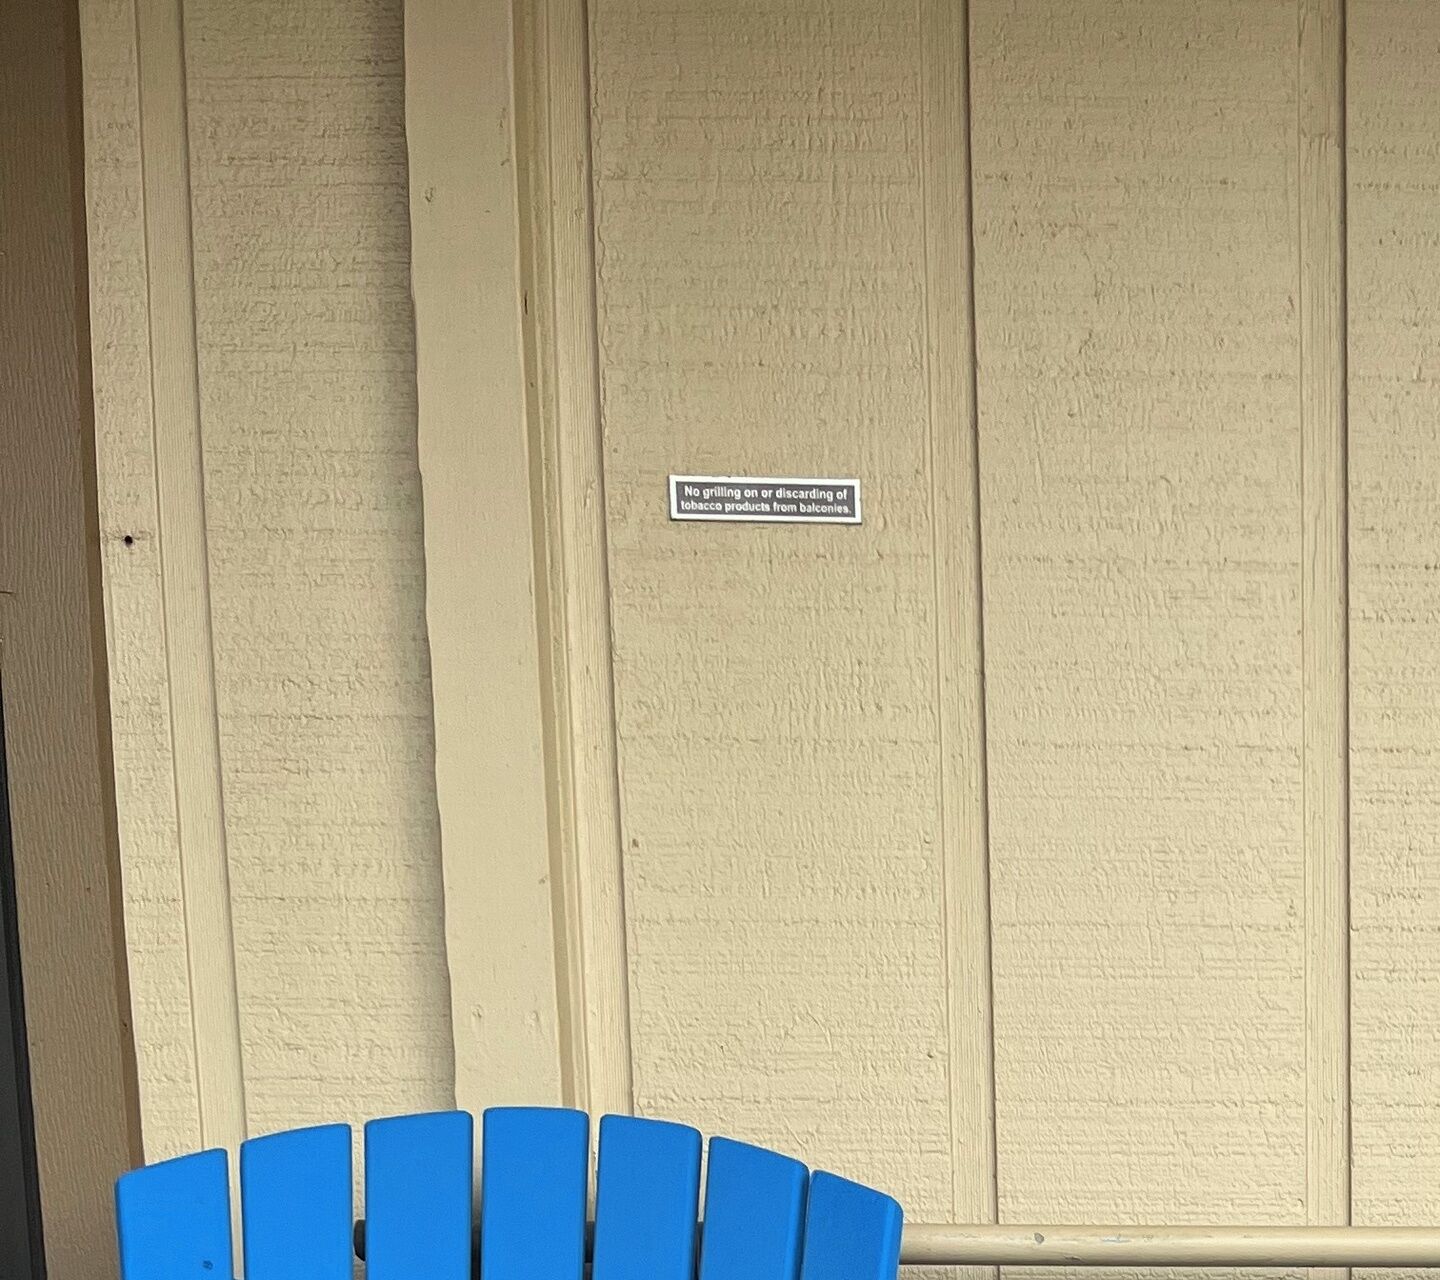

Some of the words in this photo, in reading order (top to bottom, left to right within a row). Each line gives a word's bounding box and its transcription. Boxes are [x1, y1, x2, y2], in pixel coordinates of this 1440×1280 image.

[684, 485, 700, 497] No
[703, 486, 741, 500] grilling
[744, 489, 758, 498] on
[761, 489, 773, 498] or
[775, 487, 833, 502] discarding
[836, 488, 848, 500] of
[680, 500, 722, 511] tobacco
[724, 501, 770, 513] products
[773, 501, 797, 512] from
